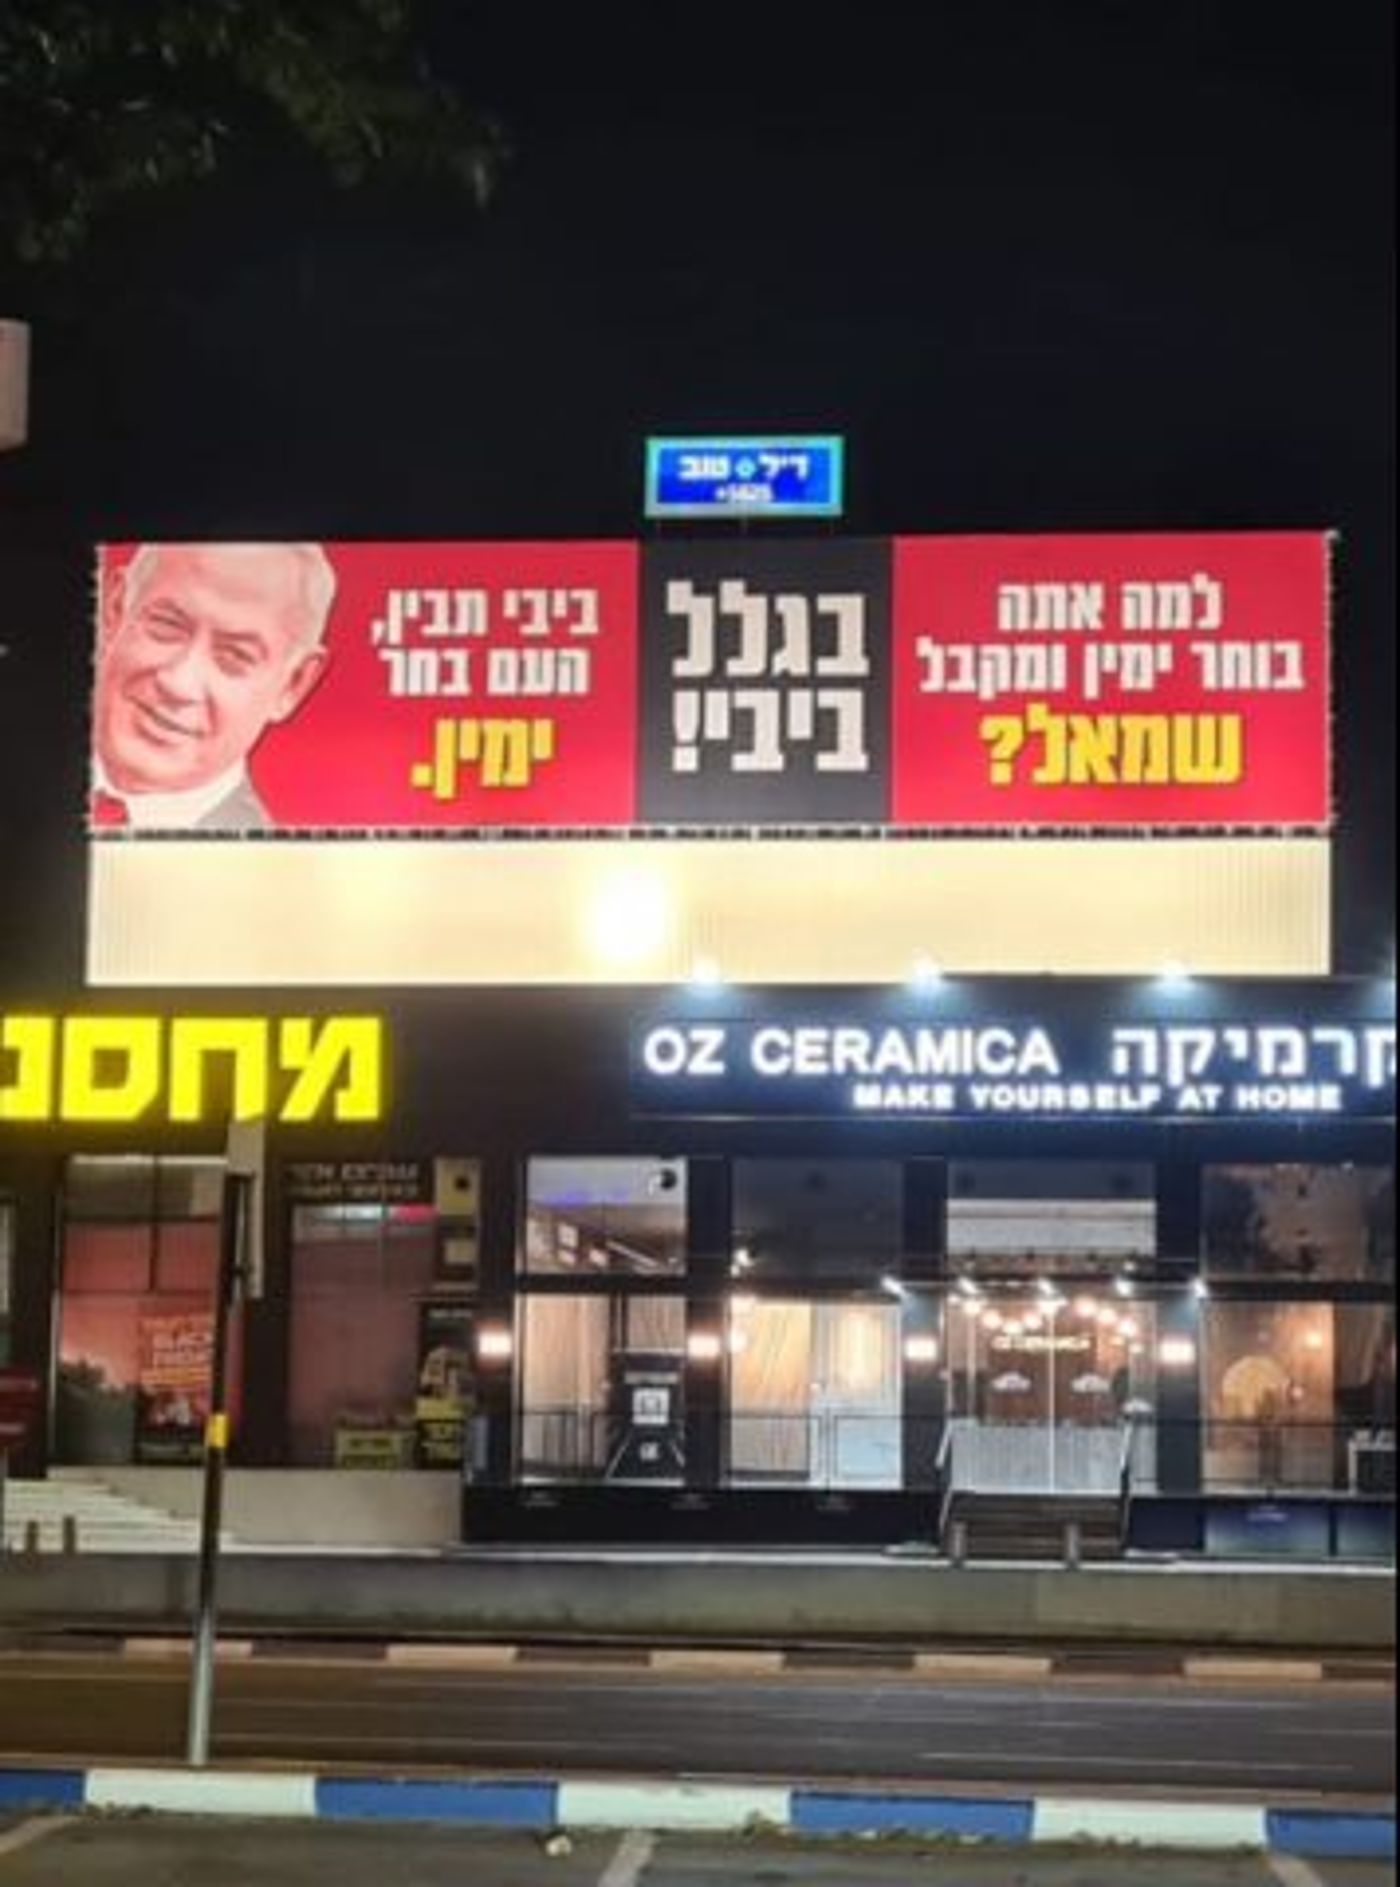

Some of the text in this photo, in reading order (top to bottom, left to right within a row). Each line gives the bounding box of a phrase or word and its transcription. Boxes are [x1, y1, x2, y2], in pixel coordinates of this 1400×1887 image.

[372, 589, 598, 644] ביבי תבין,
[667, 580, 869, 676] בגלל
[998, 573, 1222, 632] למה אתה
[380, 648, 589, 696] העם בחר
[916, 636, 1304, 701] בוחר ימין ומקבל
[410, 719, 554, 799] ימין.
[671, 688, 869, 773] ביבי!
[980, 702, 1243, 785] שמאל?
[642, 1026, 1060, 1076] OZ CERAMICA
[853, 1083, 1342, 1110] MAKE YOURSELF AT HOME
